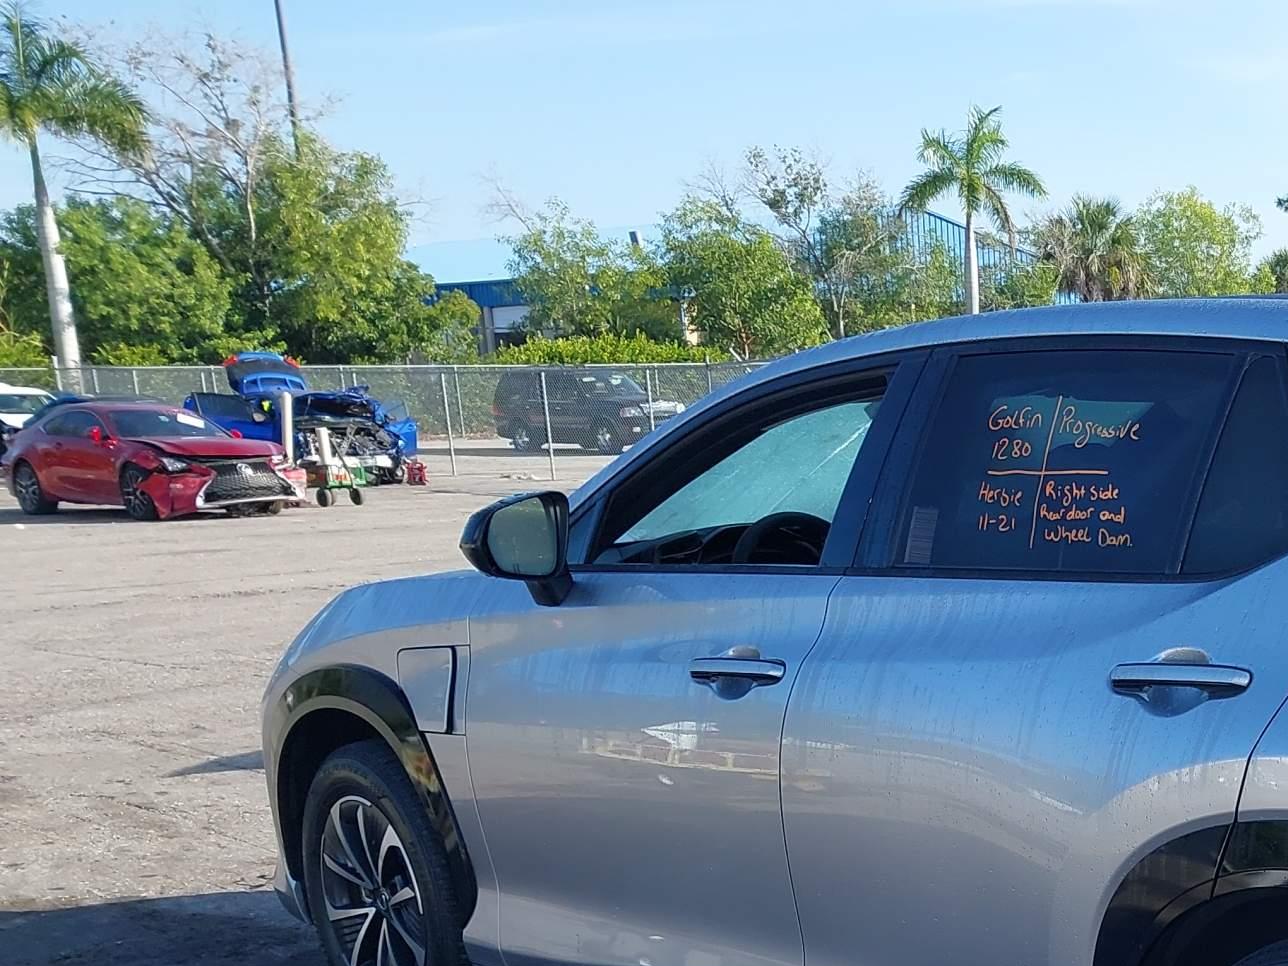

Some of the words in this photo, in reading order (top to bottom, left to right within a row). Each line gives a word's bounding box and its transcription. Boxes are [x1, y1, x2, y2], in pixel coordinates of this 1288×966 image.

[1059, 405, 1141, 448] Progressive
[991, 437, 1032, 460] 1280
[1045, 480, 1086, 506] Right
[978, 512, 1016, 532] 11-21
[1039, 503, 1065, 520] Rear
[1066, 503, 1095, 520] door
[1099, 506, 1125, 524] and
